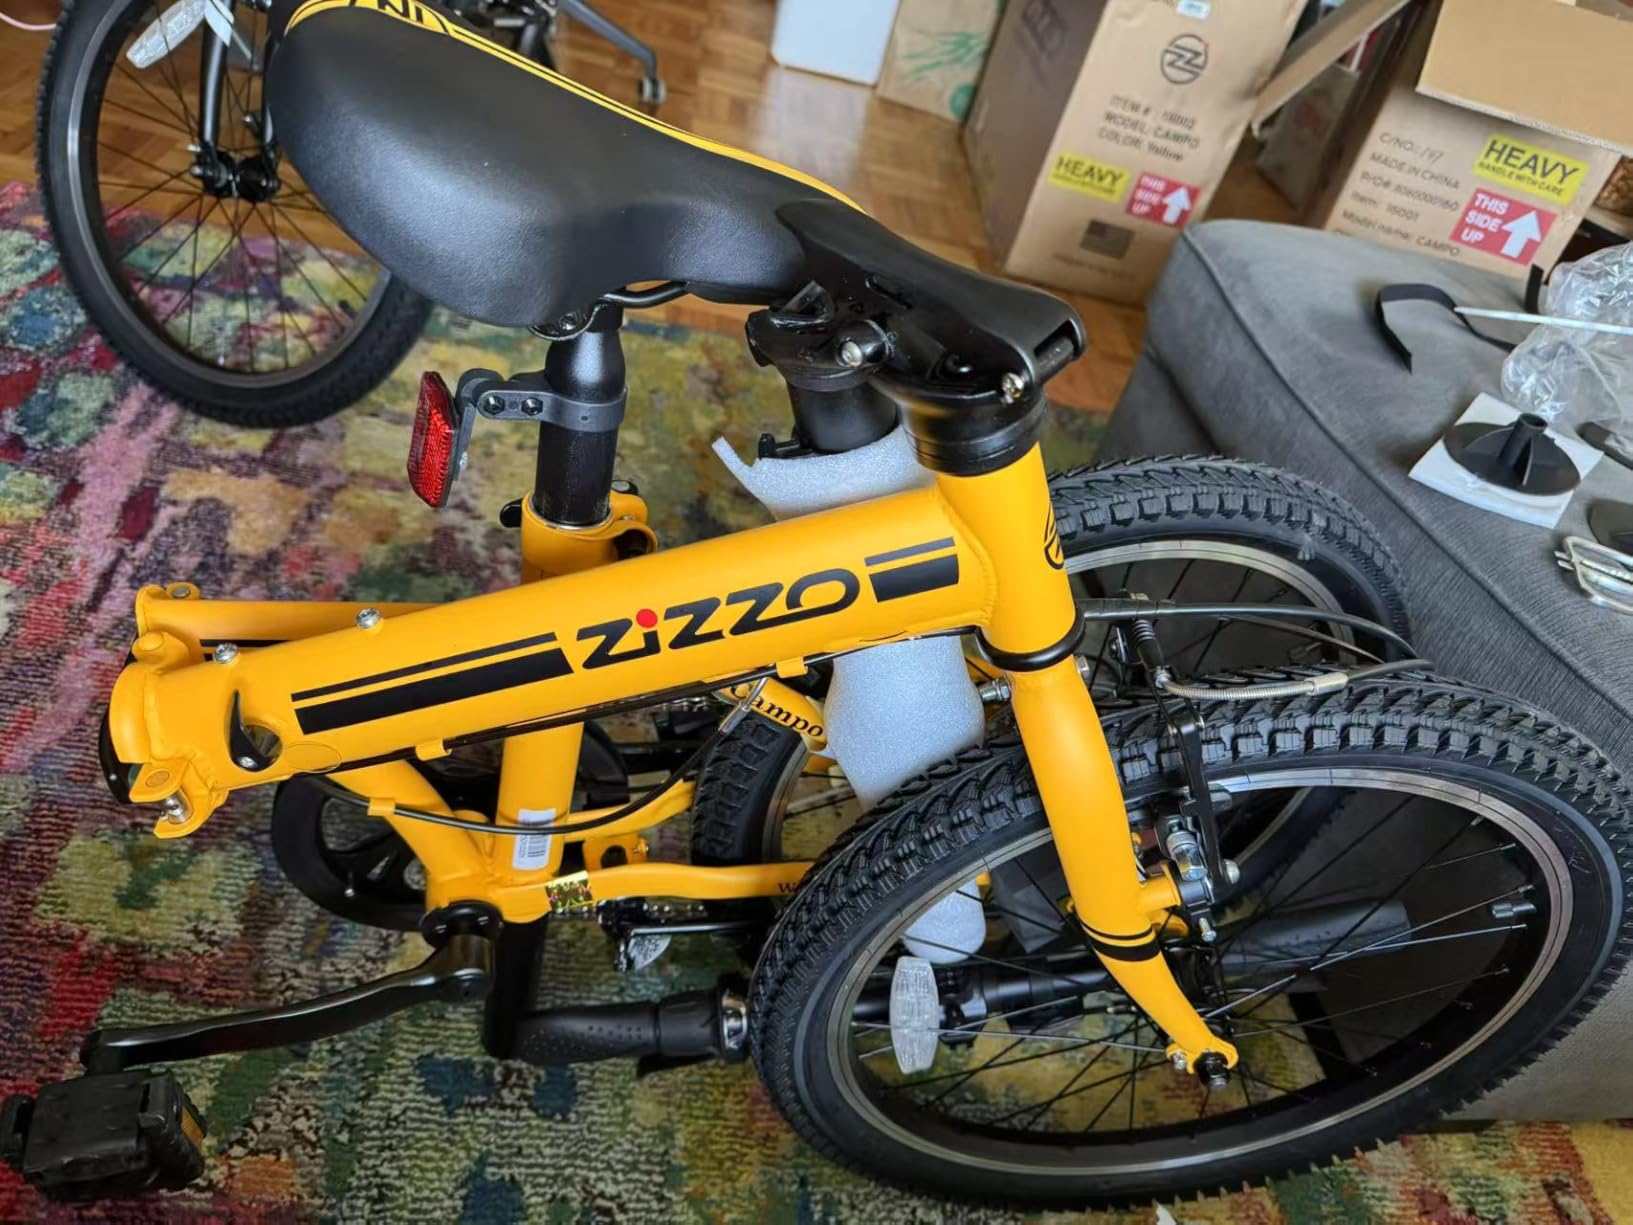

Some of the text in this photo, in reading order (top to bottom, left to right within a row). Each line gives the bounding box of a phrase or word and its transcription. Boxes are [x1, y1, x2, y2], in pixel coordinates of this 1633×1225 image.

[1056, 155, 1125, 186] HEAVY
[1368, 151, 1459, 190] MADE IN CHINA
[1485, 139, 1580, 185] HEAVY
[1478, 161, 1516, 180] HANDLE
[1537, 181, 1565, 197] CARE
[1131, 201, 1151, 215] UP
[1475, 192, 1510, 216] THIS
[1465, 209, 1503, 233] SIDE
[1415, 235, 1461, 257] CAMPO
[1461, 227, 1485, 243] UP
